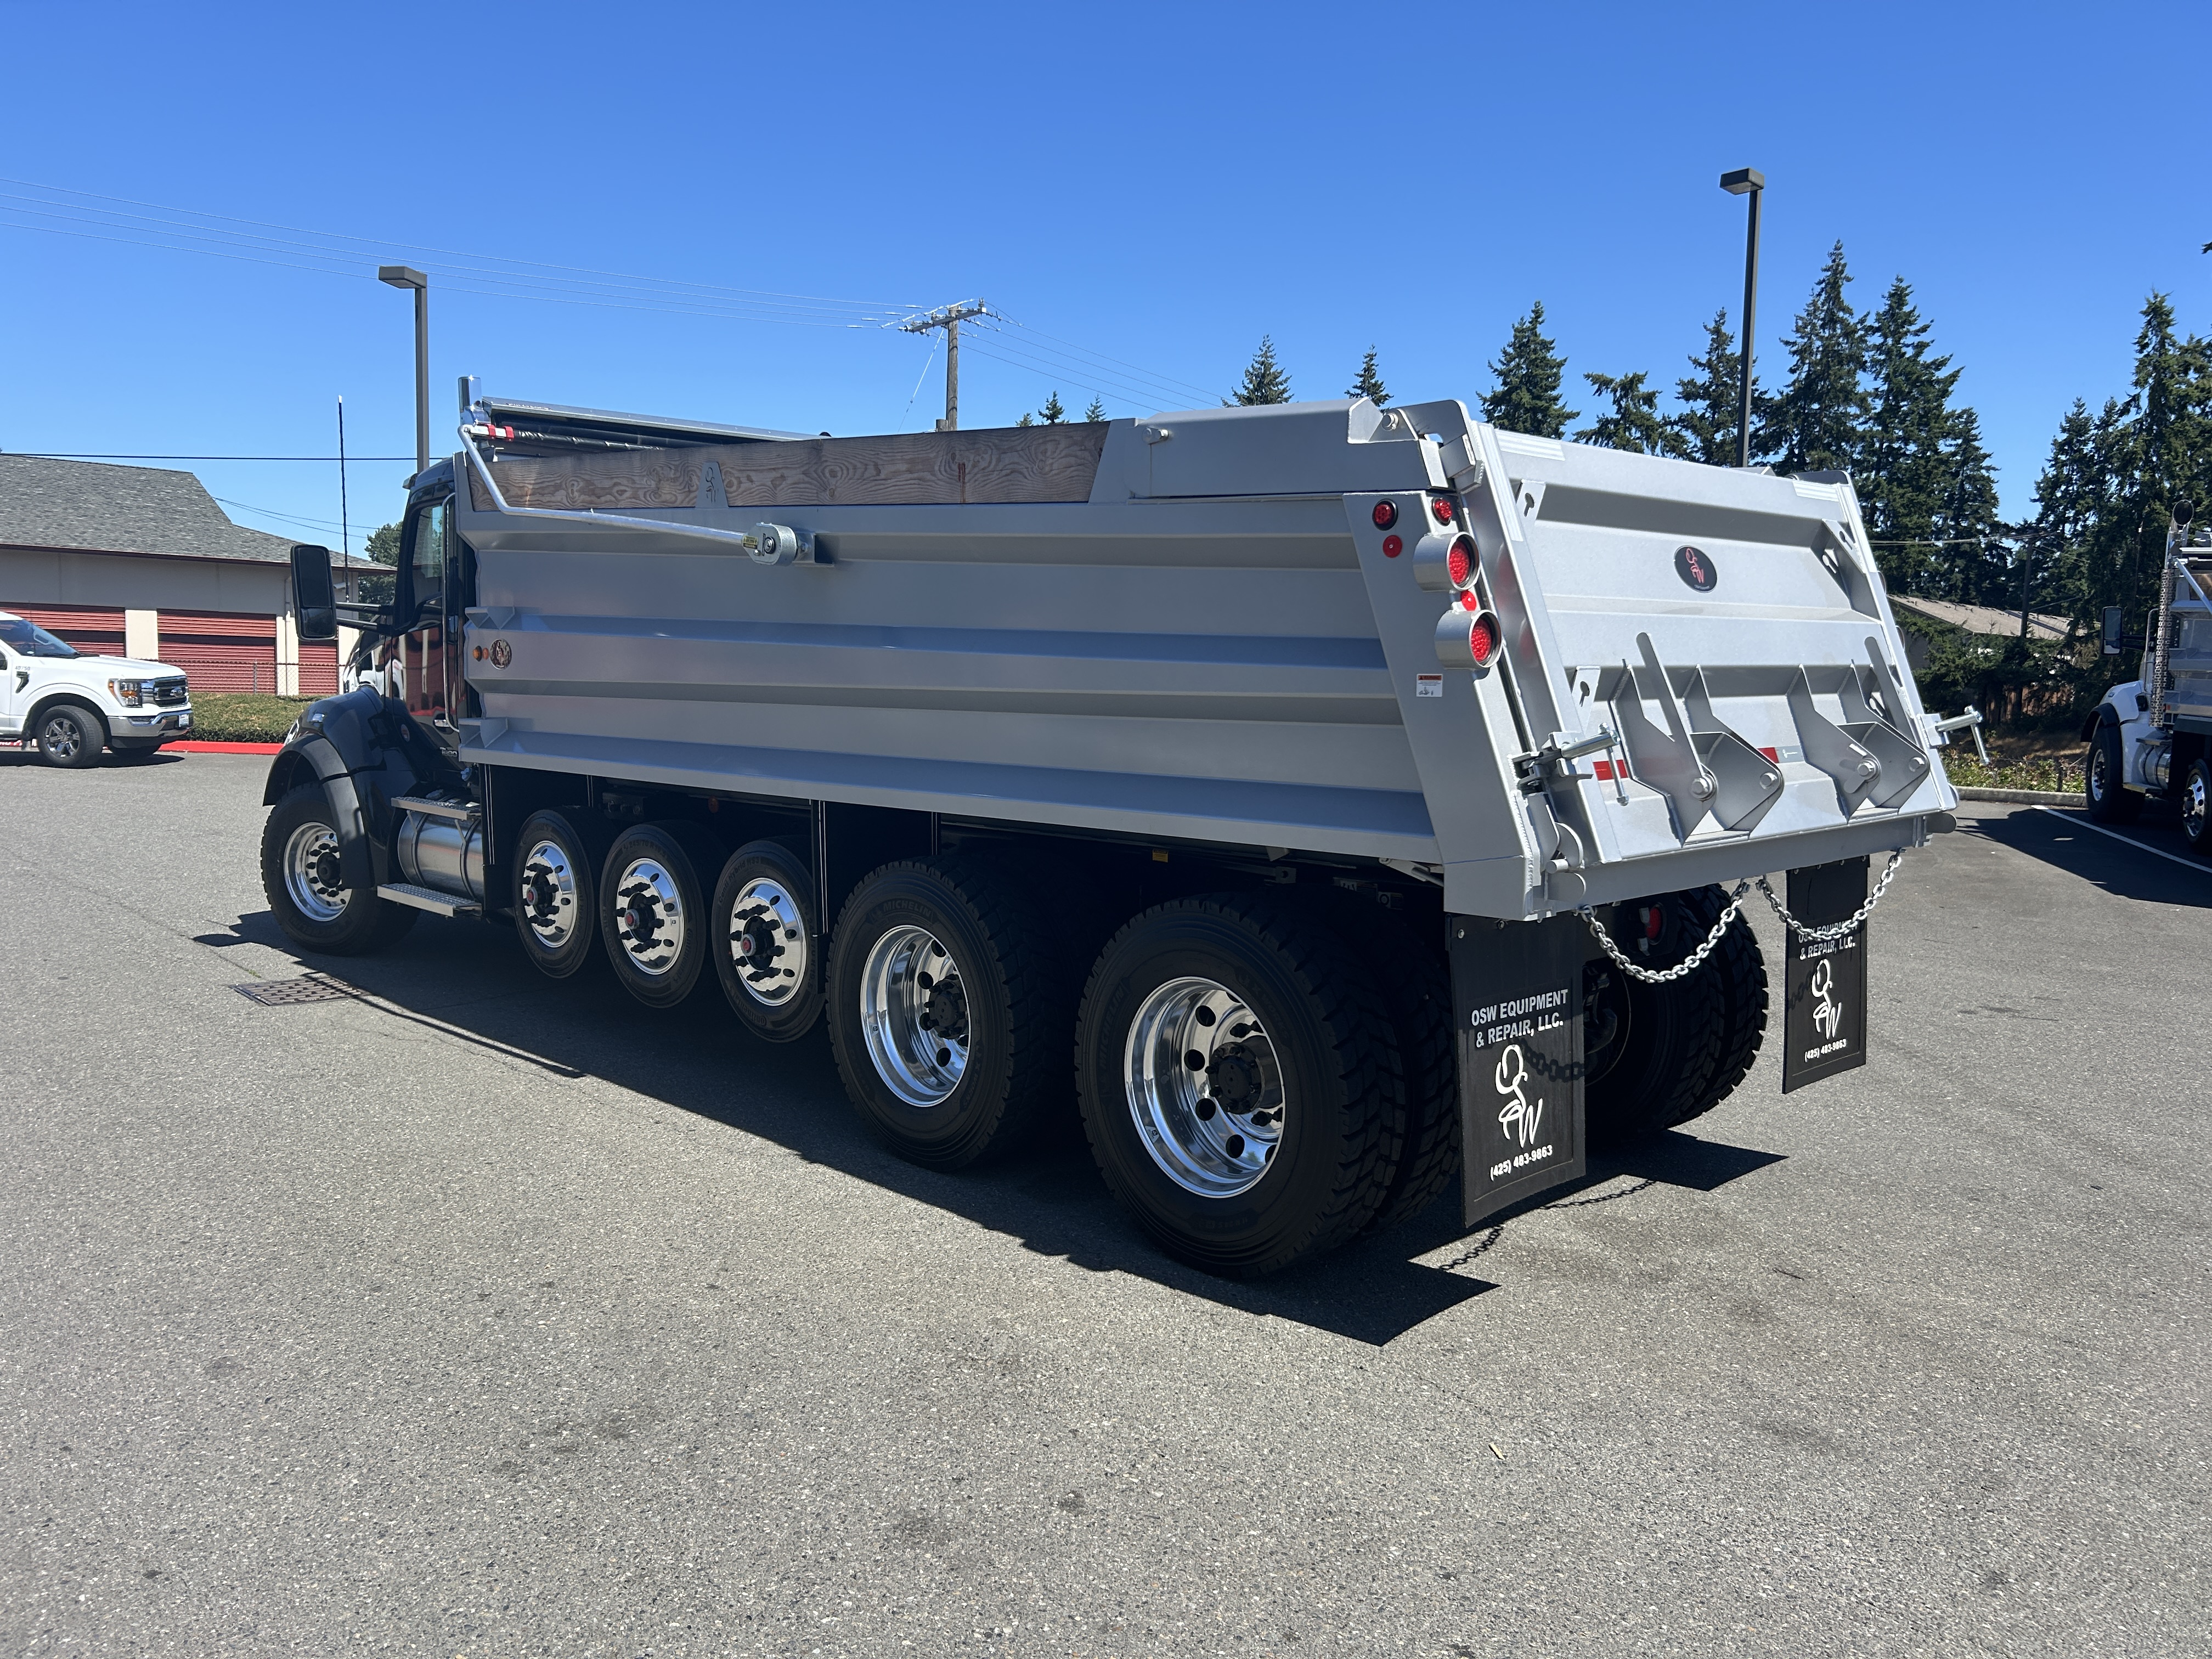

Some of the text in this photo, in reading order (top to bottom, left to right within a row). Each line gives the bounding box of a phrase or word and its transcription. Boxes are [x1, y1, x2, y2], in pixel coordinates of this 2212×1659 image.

[883, 900, 932, 917] MICHELIN
[1799, 947, 1806, 960] &
[1807, 940, 1837, 958] REPAIR,
[1471, 989, 1568, 1026] OSW EQUIPMENT
[1100, 985, 1124, 1068] MICHELIN
[1476, 1012, 1564, 1048] & REPAIR, LLC.
[1804, 1039, 1847, 1063] (425) 483-9863
[1490, 1144, 1553, 1181] (425) 483-9863
